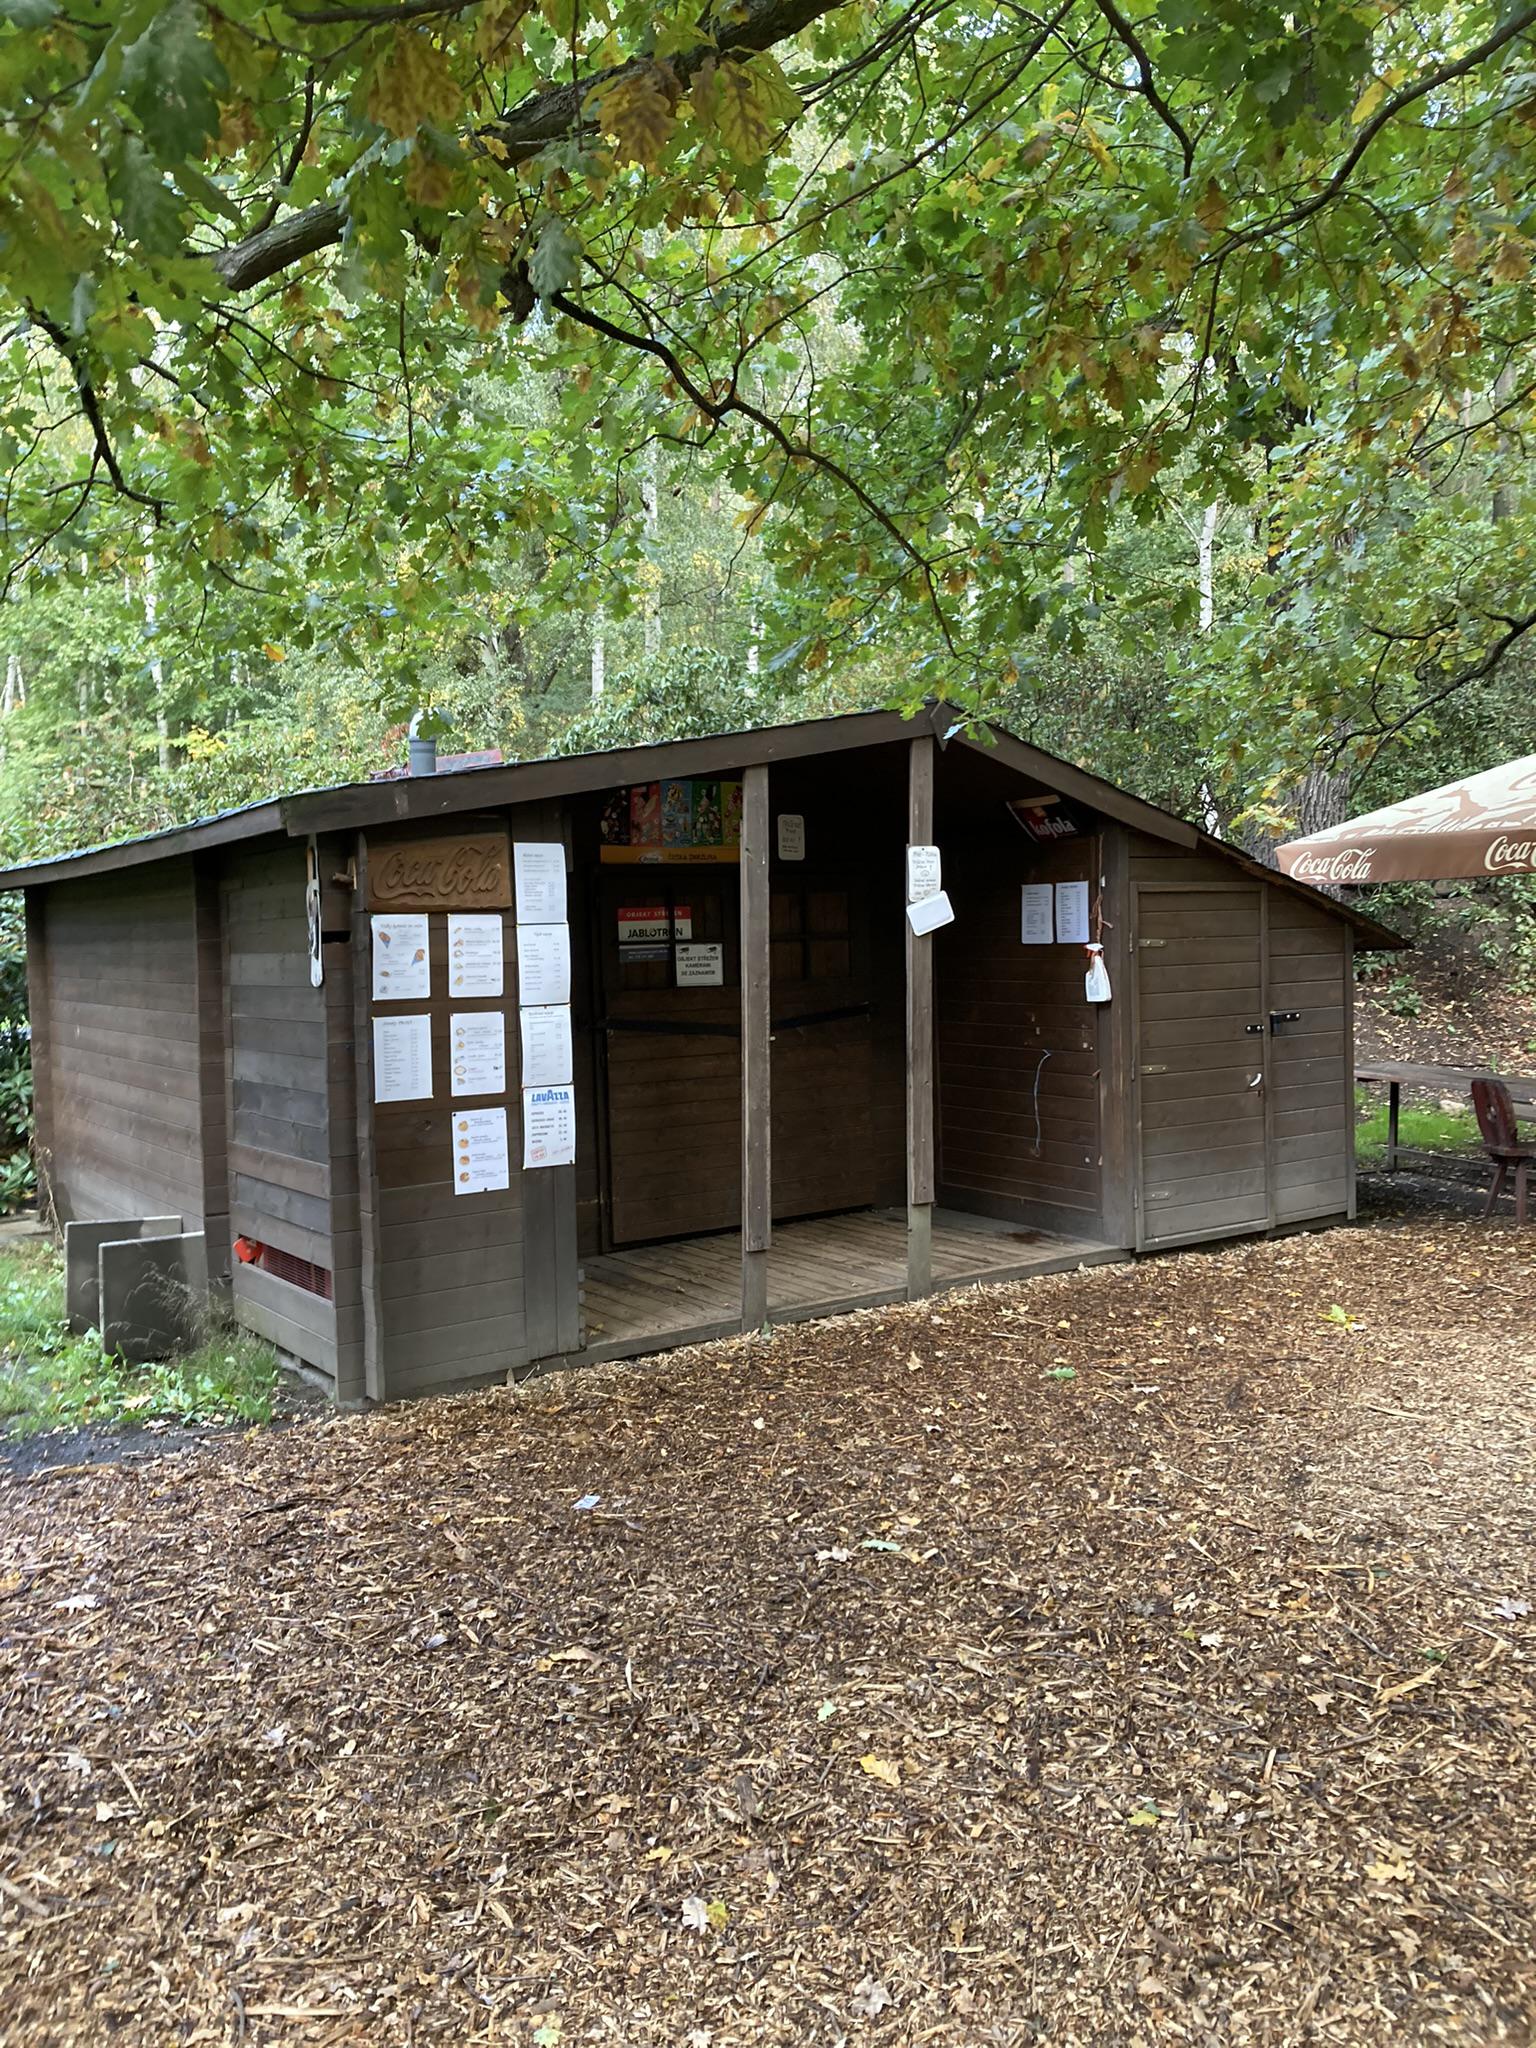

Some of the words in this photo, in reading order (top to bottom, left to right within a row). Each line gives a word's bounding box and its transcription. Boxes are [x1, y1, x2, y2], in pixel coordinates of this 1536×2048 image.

[1028, 817, 1077, 839] kofola
[1484, 836, 1536, 870] Coca-
[1290, 848, 1377, 881] Coca-Cola
[654, 909, 683, 917] STŘEN
[531, 1089, 570, 1102] LAVAZZA
